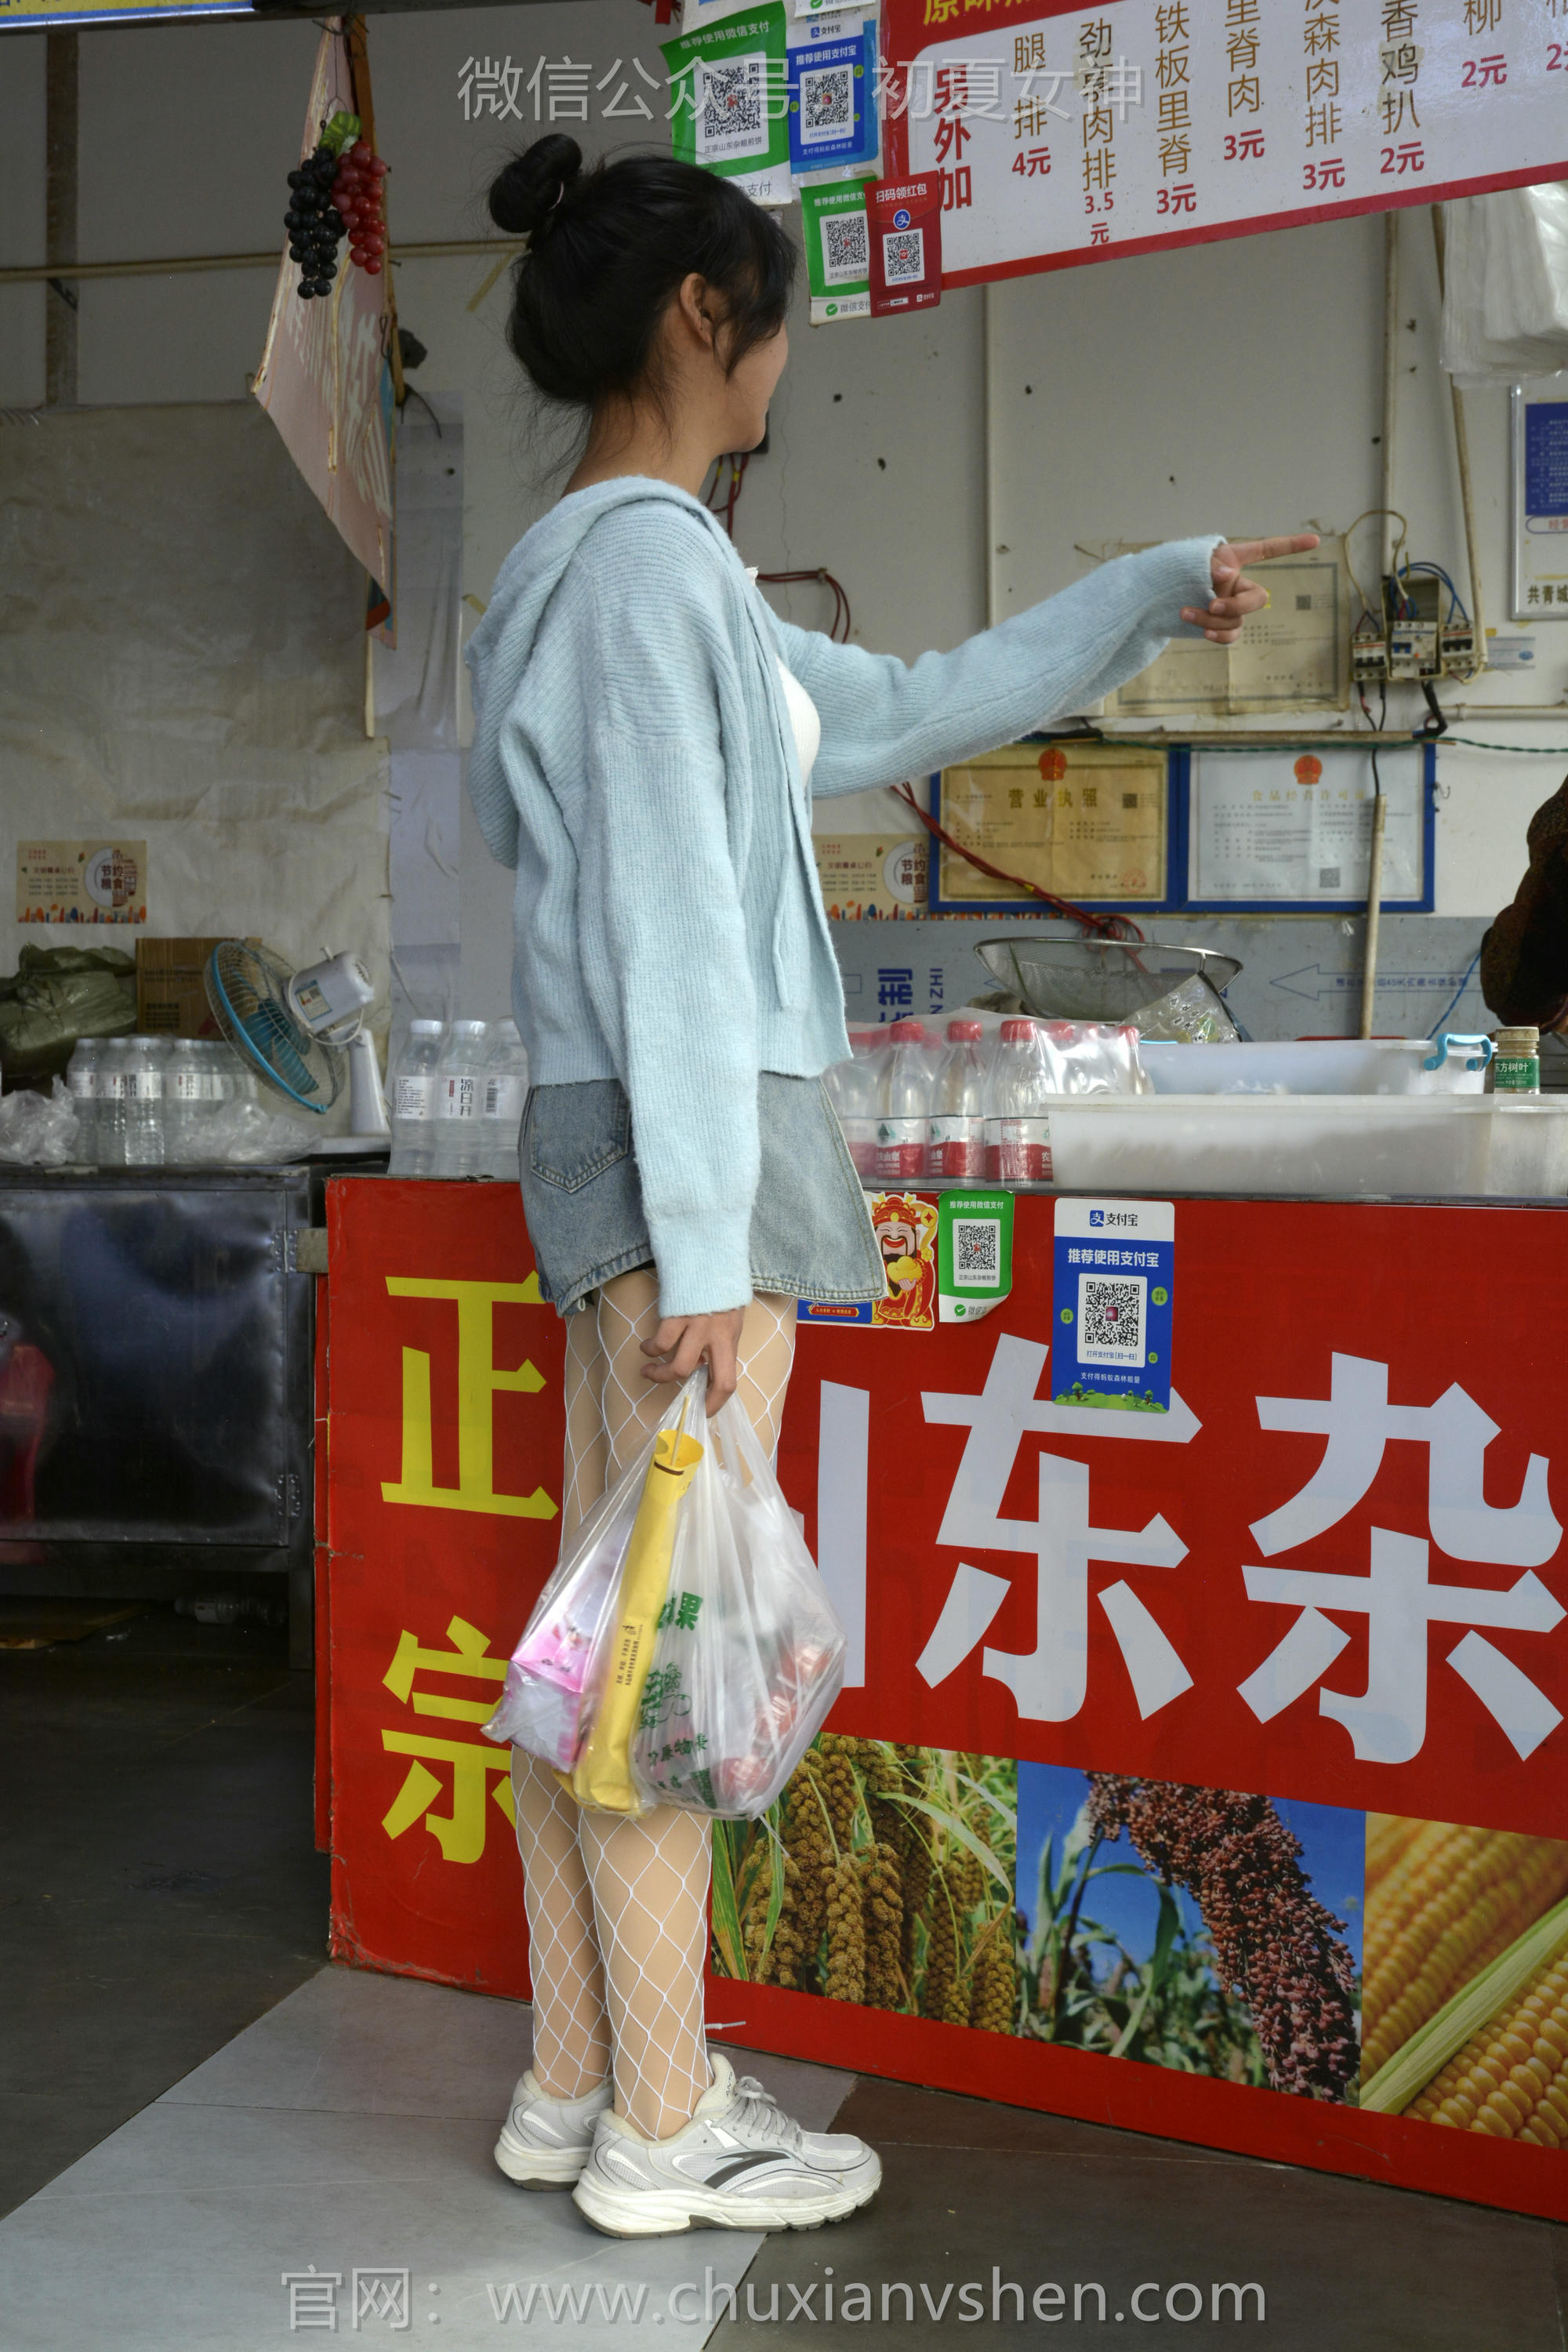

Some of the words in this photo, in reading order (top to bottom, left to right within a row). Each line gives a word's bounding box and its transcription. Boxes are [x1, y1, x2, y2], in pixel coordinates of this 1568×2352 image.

[680, 20, 770, 49] 推荐使用微信支付
[820, 24, 841, 35] 支付宝
[796, 45, 857, 66] 推荐使用支付宝
[1304, 0, 1343, 147] 森肉排
[1461, 53, 1508, 88] 2元
[1154, 2, 1192, 177] 铁板里脊
[1223, 128, 1265, 162] 3元
[1011, 146, 1051, 177] 4元
[1380, 141, 1425, 175] 2元
[1302, 158, 1346, 191] 3元
[814, 191, 866, 207] 推荐使用微信支
[875, 183, 927, 204] 扫码领红包
[1083, 191, 1115, 214] 3.5
[1156, 183, 1197, 215] 3元
[1091, 222, 1110, 245] 元
[1008, 787, 1098, 809] 营业执照
[949, 1200, 1004, 1210] 推荐使用微信支付
[1105, 1212, 1138, 1227] 支付宝
[1067, 1247, 1160, 1268] 推荐使用支付宝
